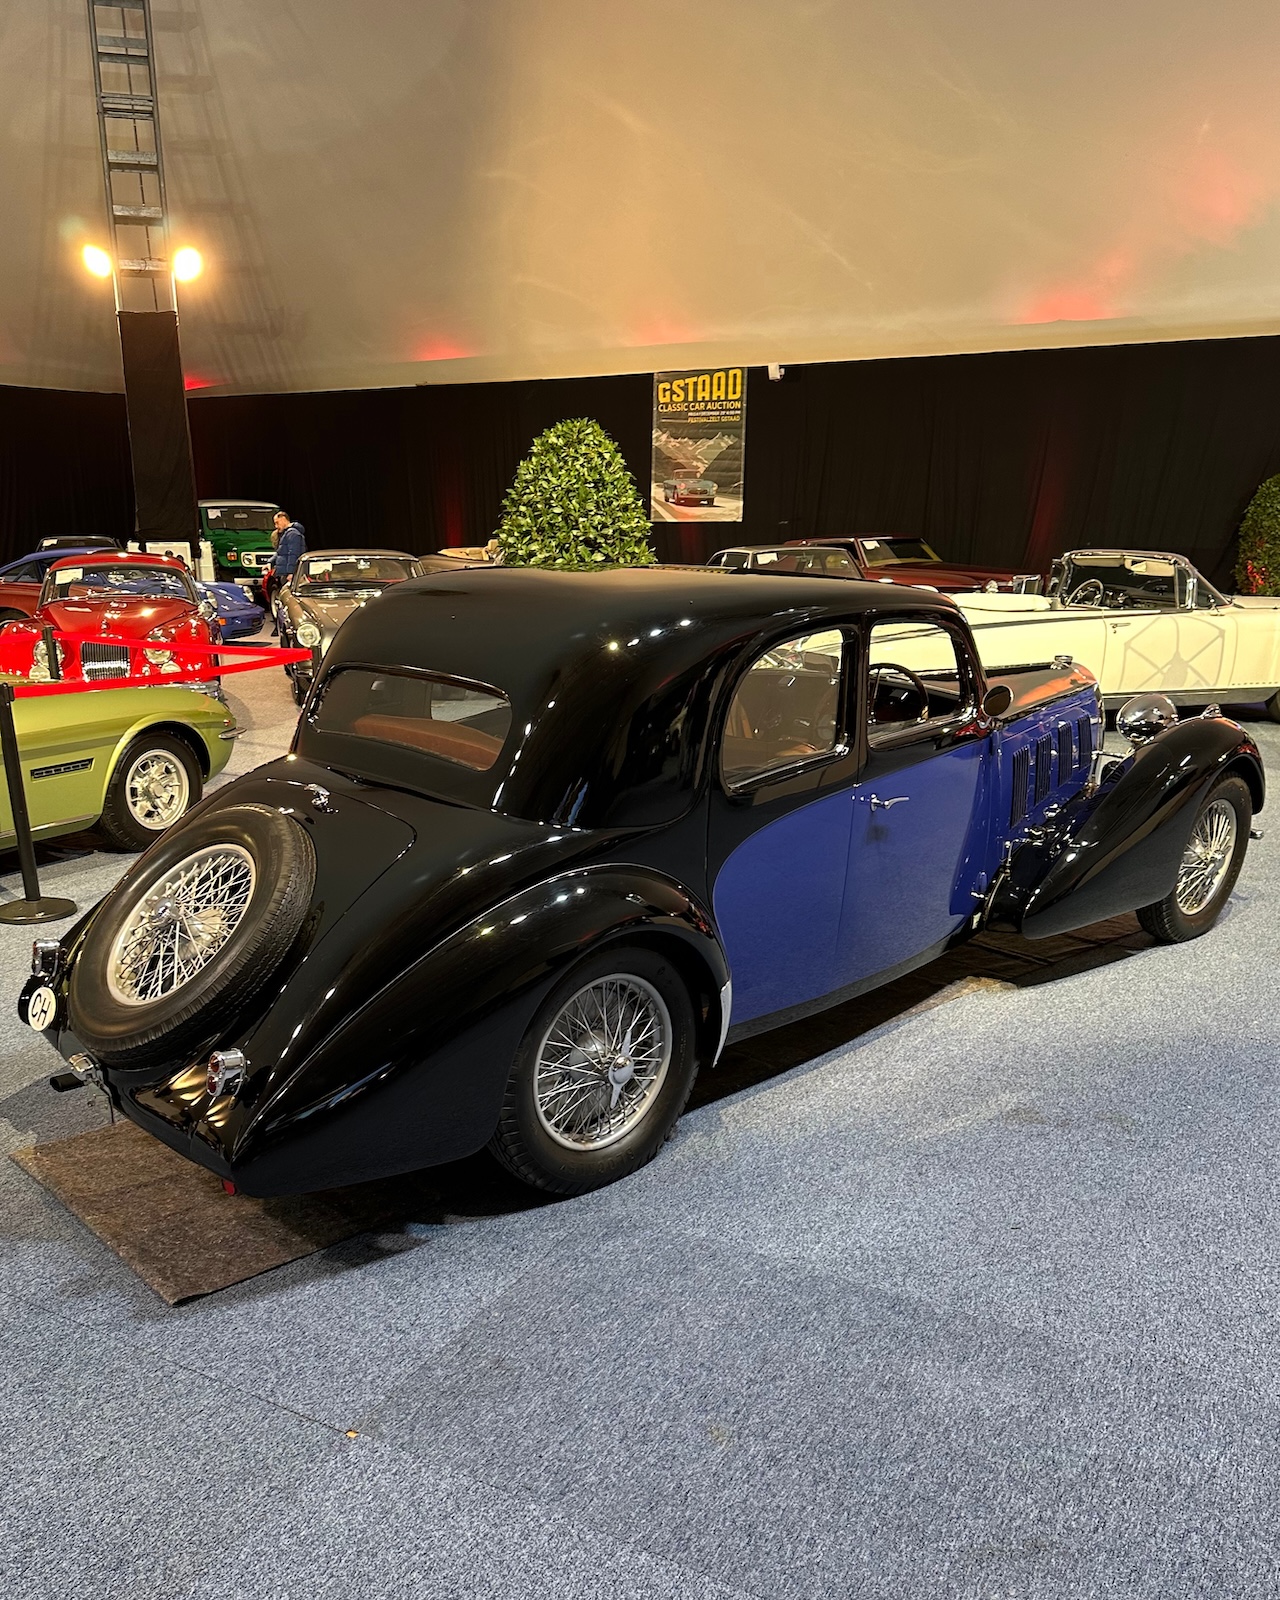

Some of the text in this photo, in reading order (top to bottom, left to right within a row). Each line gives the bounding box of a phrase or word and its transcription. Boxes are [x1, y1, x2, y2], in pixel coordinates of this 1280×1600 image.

[658, 369, 742, 403] GSTAAD
[658, 401, 741, 413] CLASSIC CAR AUCTION
[32, 993, 51, 1026] CH
